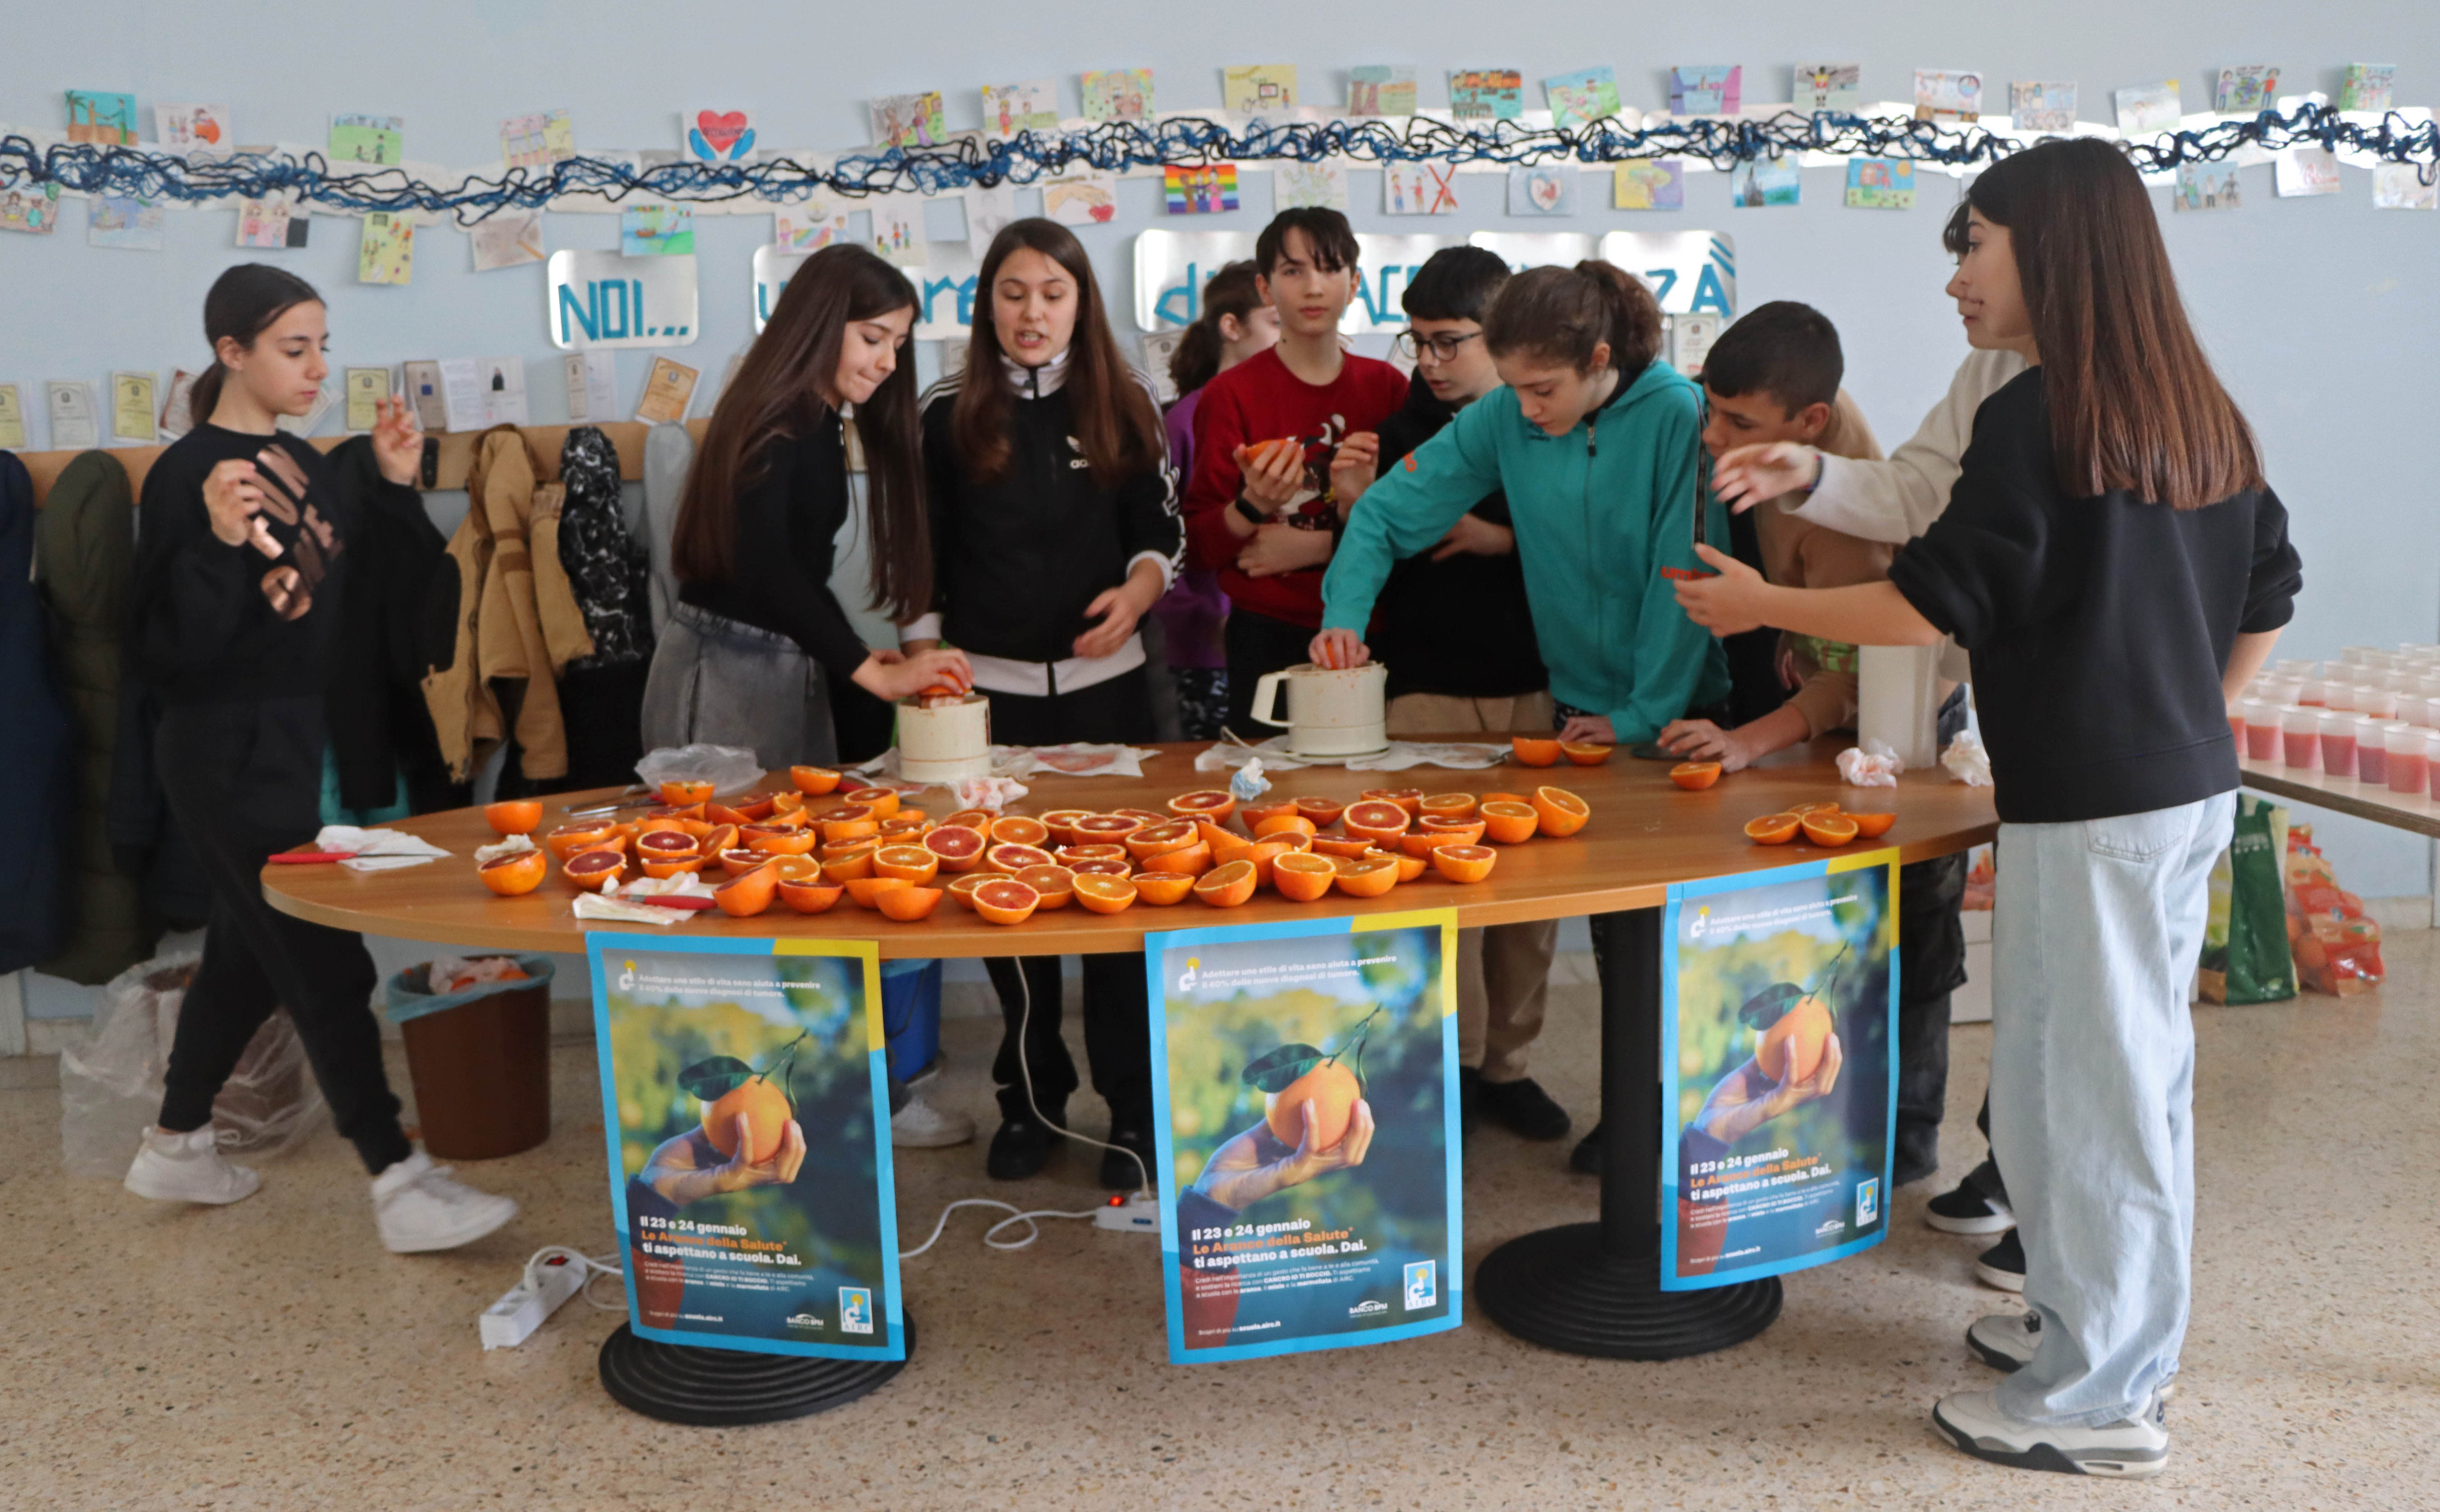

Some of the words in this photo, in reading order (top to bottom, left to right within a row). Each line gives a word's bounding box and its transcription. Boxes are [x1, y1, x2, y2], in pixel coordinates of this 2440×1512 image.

[558, 279, 688, 344] NOI...
[1202, 968, 1240, 978] Adottare
[1258, 965, 1277, 974] stile
[1358, 955, 1397, 966] prevenire
[1209, 979, 1230, 988] 40%
[1231, 977, 1251, 986] delle
[1280, 972, 1316, 983] diagnosi
[1327, 969, 1360, 978] tumore.
[1690, 1163, 1698, 1175] Il
[1700, 1160, 1716, 1173] 23
[1717, 1160, 1725, 1170] e
[1727, 1155, 1743, 1168] 24
[1744, 1147, 1789, 1167] gennaio
[1690, 1189, 1700, 1201] ti
[1702, 1180, 1761, 1199] aspettano
[1762, 1178, 1769, 1187] a
[1770, 1169, 1810, 1186] scuola.
[1810, 1163, 1832, 1178] Dai.
[1691, 1177, 1706, 1189] Le
[1707, 1171, 1750, 1186] Arance
[1752, 1163, 1781, 1177] della
[640, 1215, 649, 1227] Il
[649, 1216, 667, 1229] 23
[668, 1220, 676, 1229] e
[678, 1219, 694, 1231] 24
[696, 1223, 747, 1236] gennaio
[1192, 1228, 1201, 1241] Il
[1203, 1227, 1222, 1240] 23
[1224, 1227, 1233, 1237] e
[1235, 1223, 1254, 1236] 24
[1255, 1218, 1311, 1236] gennaio
[641, 1230, 656, 1240] Le
[659, 1231, 704, 1245] Arance
[706, 1237, 738, 1248] della
[1193, 1243, 1210, 1255] Le
[1212, 1240, 1263, 1253] Arance
[1266, 1233, 1301, 1247] della
[642, 1241, 653, 1253] ti
[654, 1244, 717, 1259] aspettano
[719, 1251, 727, 1260] a
[729, 1251, 775, 1263] scuola.
[776, 1253, 802, 1265] Dai.
[1194, 1255, 1205, 1268] ti
[1207, 1251, 1277, 1268] aspettano
[1279, 1249, 1288, 1259] a
[1290, 1242, 1339, 1258] scuola.
[1340, 1238, 1367, 1253] Dai.
[1349, 1304, 1374, 1314] BANCO
